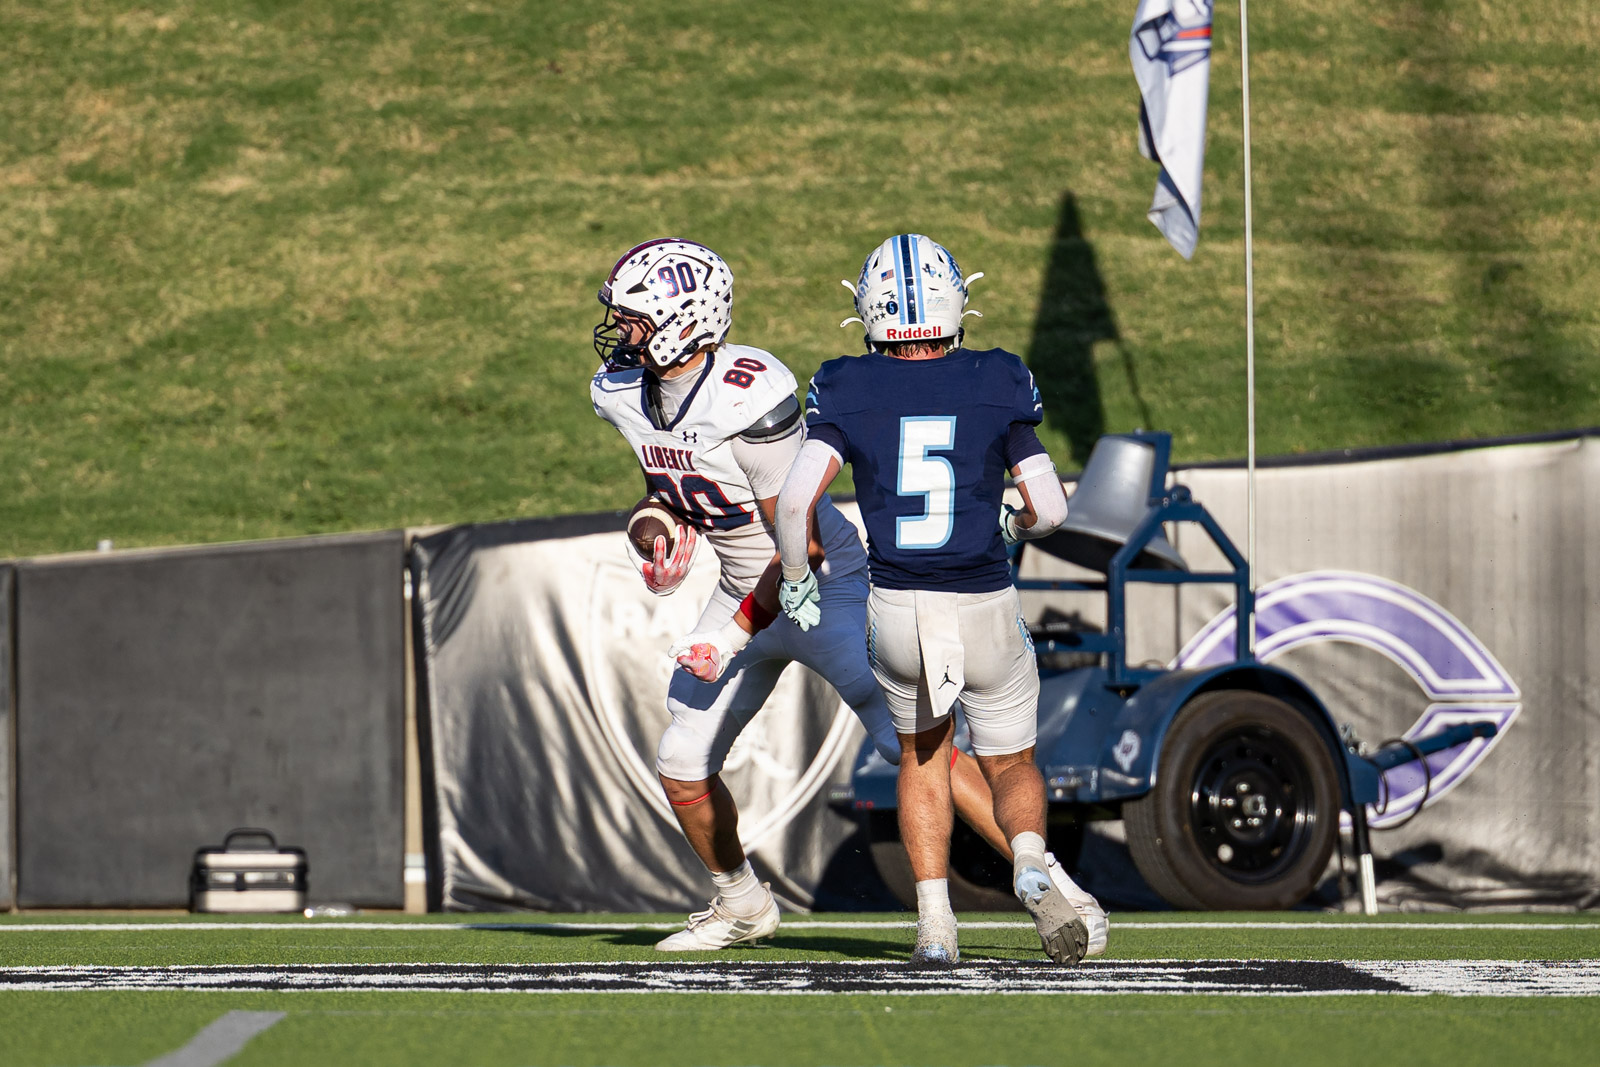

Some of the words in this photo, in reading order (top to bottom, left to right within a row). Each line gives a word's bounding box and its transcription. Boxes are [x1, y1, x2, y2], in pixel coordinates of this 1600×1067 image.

[888, 302, 895, 314] 5
[886, 326, 942, 340] Riddell
[722, 357, 768, 390] 80
[641, 444, 697, 472] LIBERTY
[896, 415, 957, 550] 5
